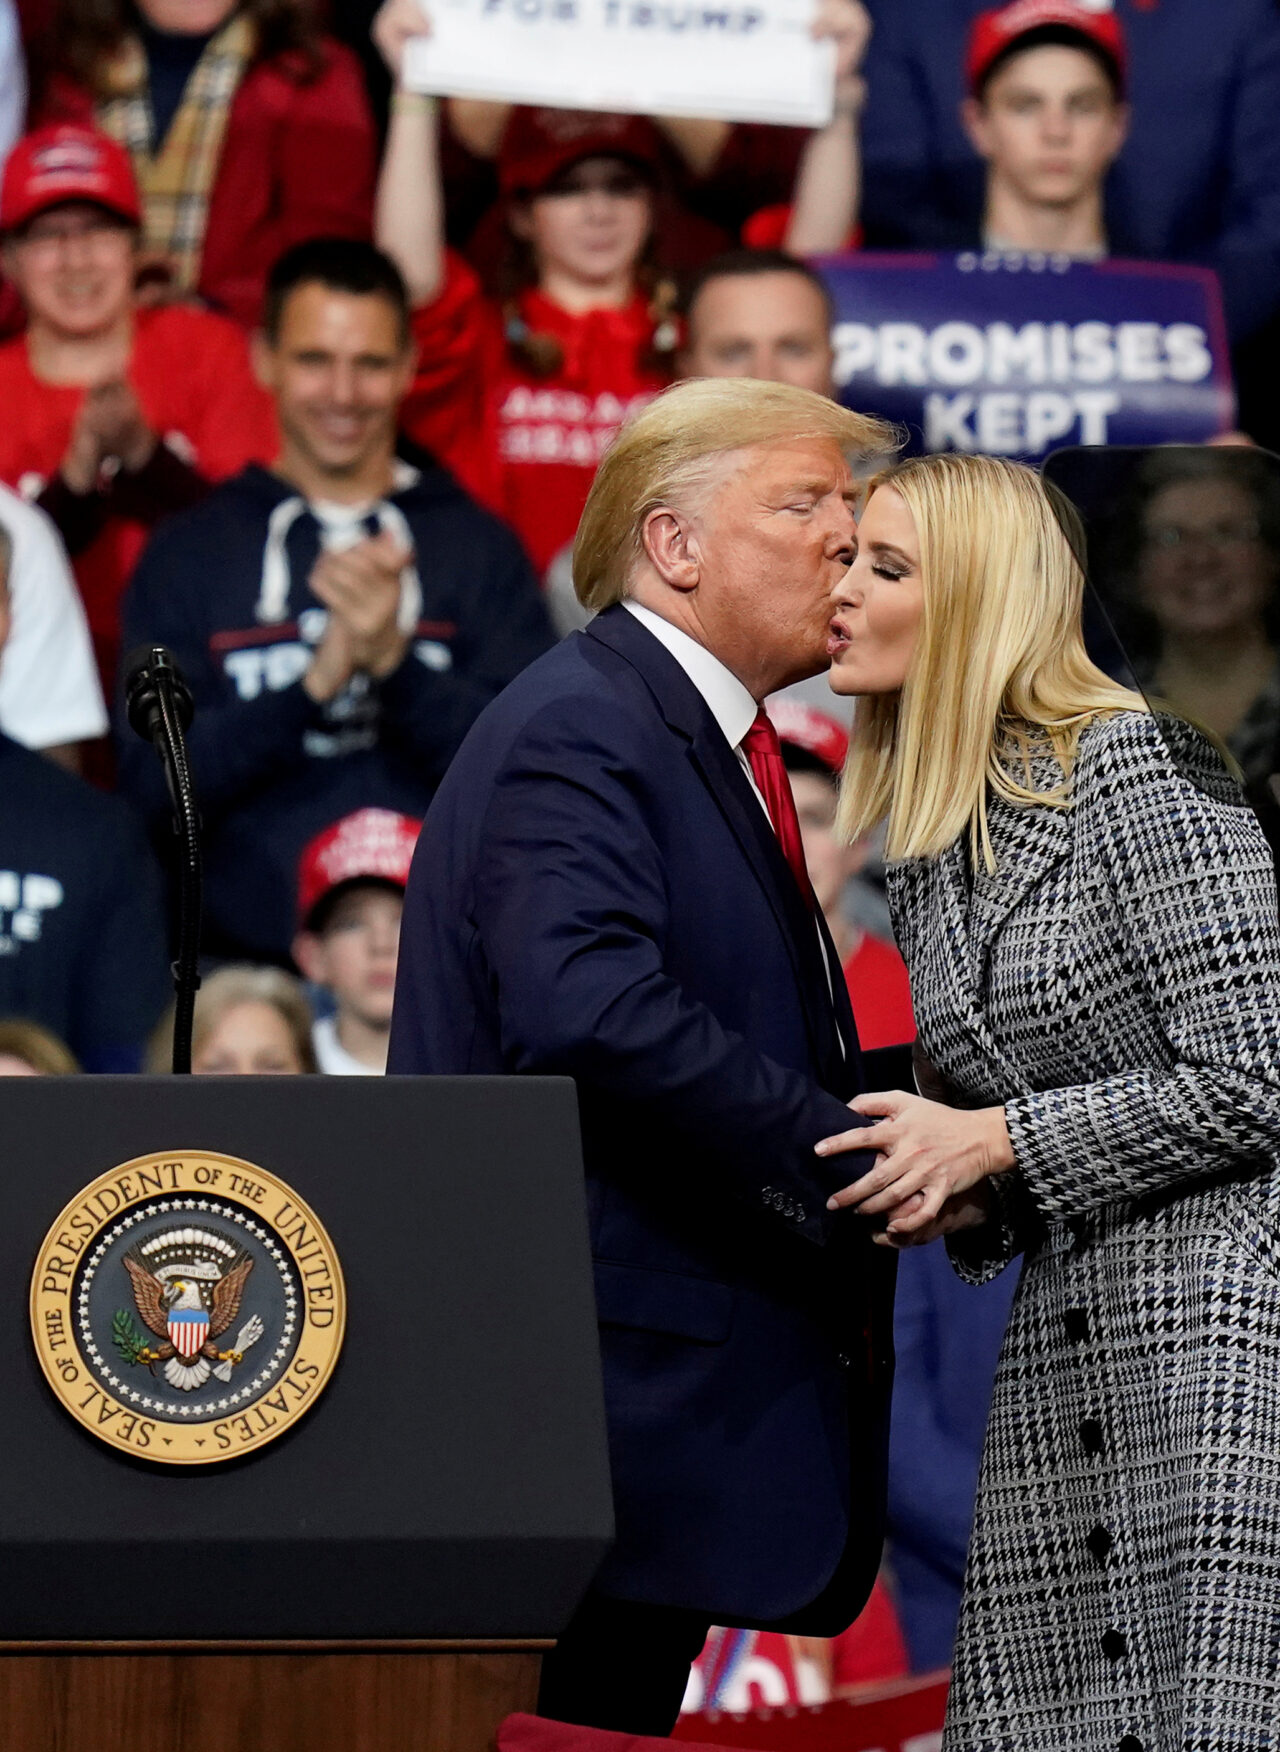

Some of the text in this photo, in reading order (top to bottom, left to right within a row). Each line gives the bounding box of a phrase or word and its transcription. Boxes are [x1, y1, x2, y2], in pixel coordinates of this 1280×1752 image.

[604, 0, 765, 35] TRUMP
[830, 321, 1212, 386] PROMISES
[925, 391, 1120, 453] KEPT
[42, 1162, 335, 1449] SEAL OF THE PRESIDENT OF THE UNITED STATES
